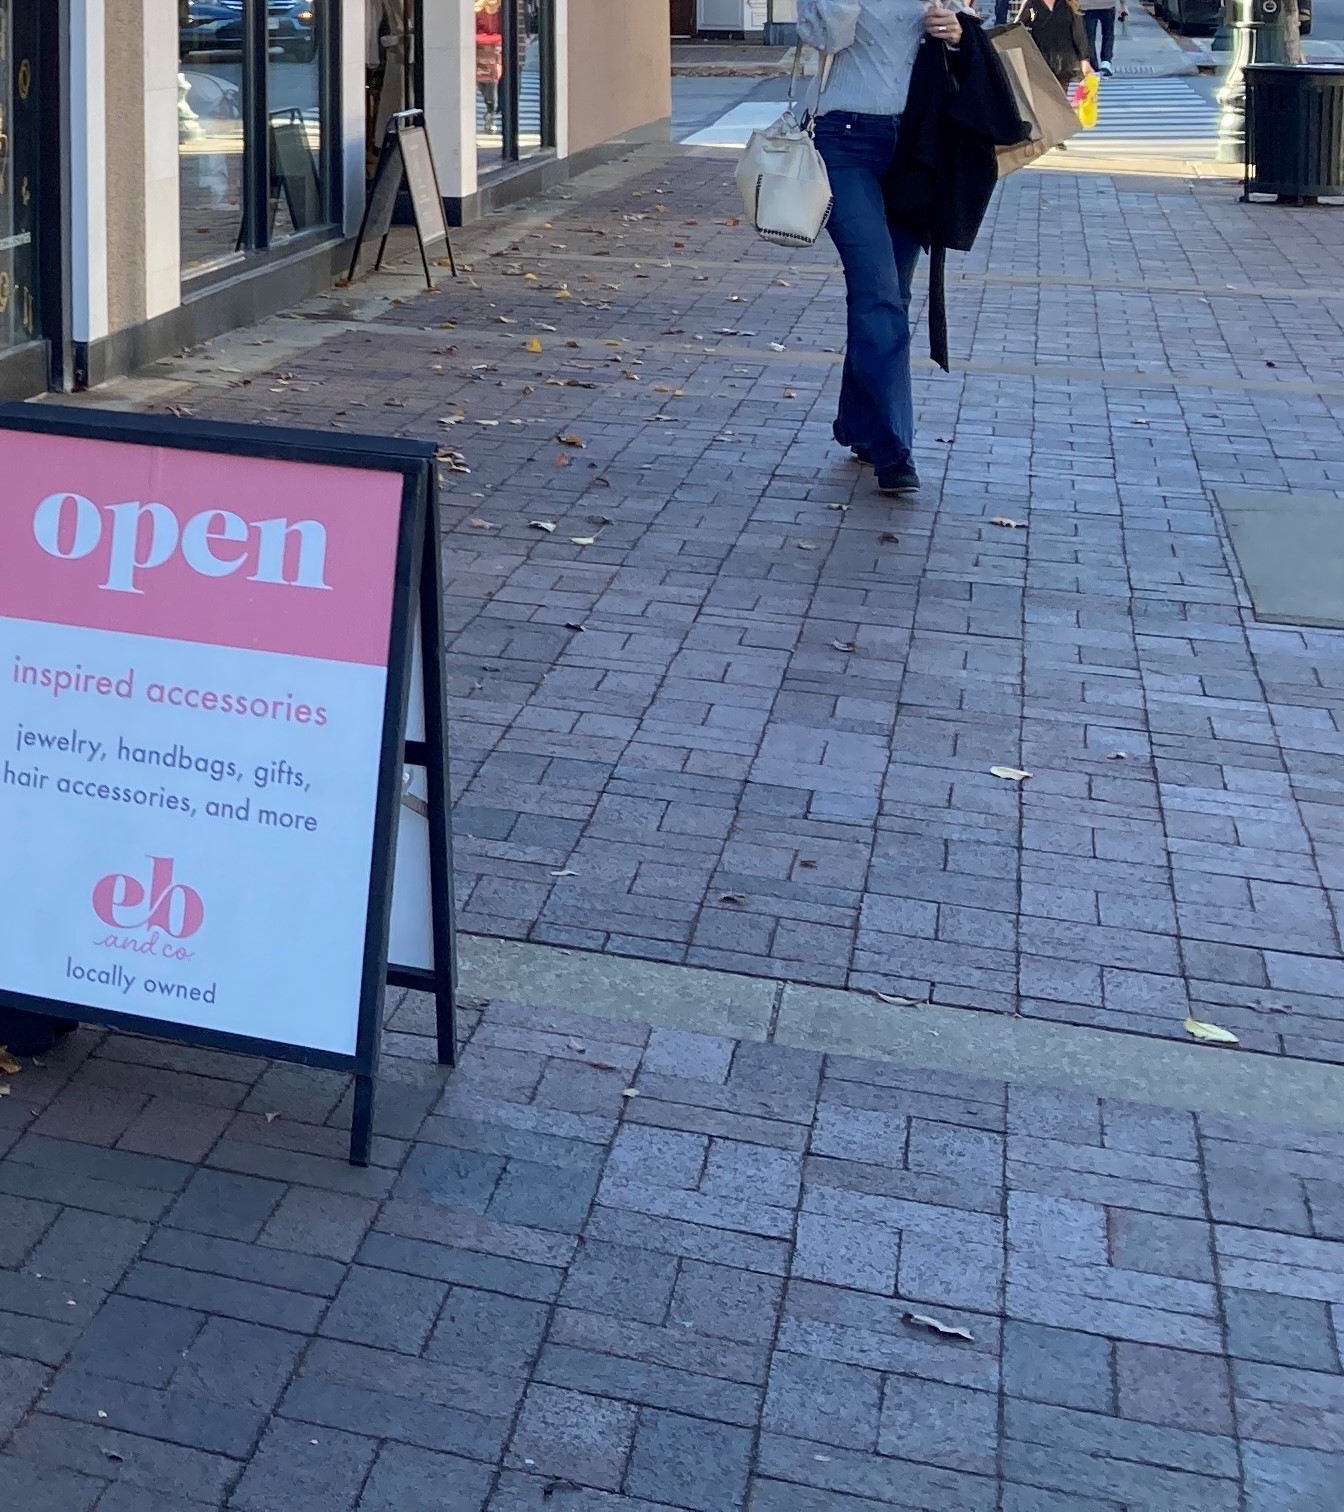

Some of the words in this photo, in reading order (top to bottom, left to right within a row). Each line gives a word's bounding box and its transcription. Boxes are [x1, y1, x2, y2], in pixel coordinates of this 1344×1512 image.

[33, 492, 333, 594] open
[12, 655, 135, 697] inspired
[145, 682, 328, 726] accessories
[15, 723, 107, 763] jewelry,
[117, 736, 244, 783] handbags,
[254, 759, 311, 792] gifts,
[3, 760, 49, 789] hair
[56, 777, 197, 818] accessories,
[205, 797, 250, 822] and
[258, 807, 318, 832] more
[92, 853, 205, 939] eb
[93, 930, 157, 956] and
[66, 955, 136, 995] locally
[143, 978, 217, 1004] owned
